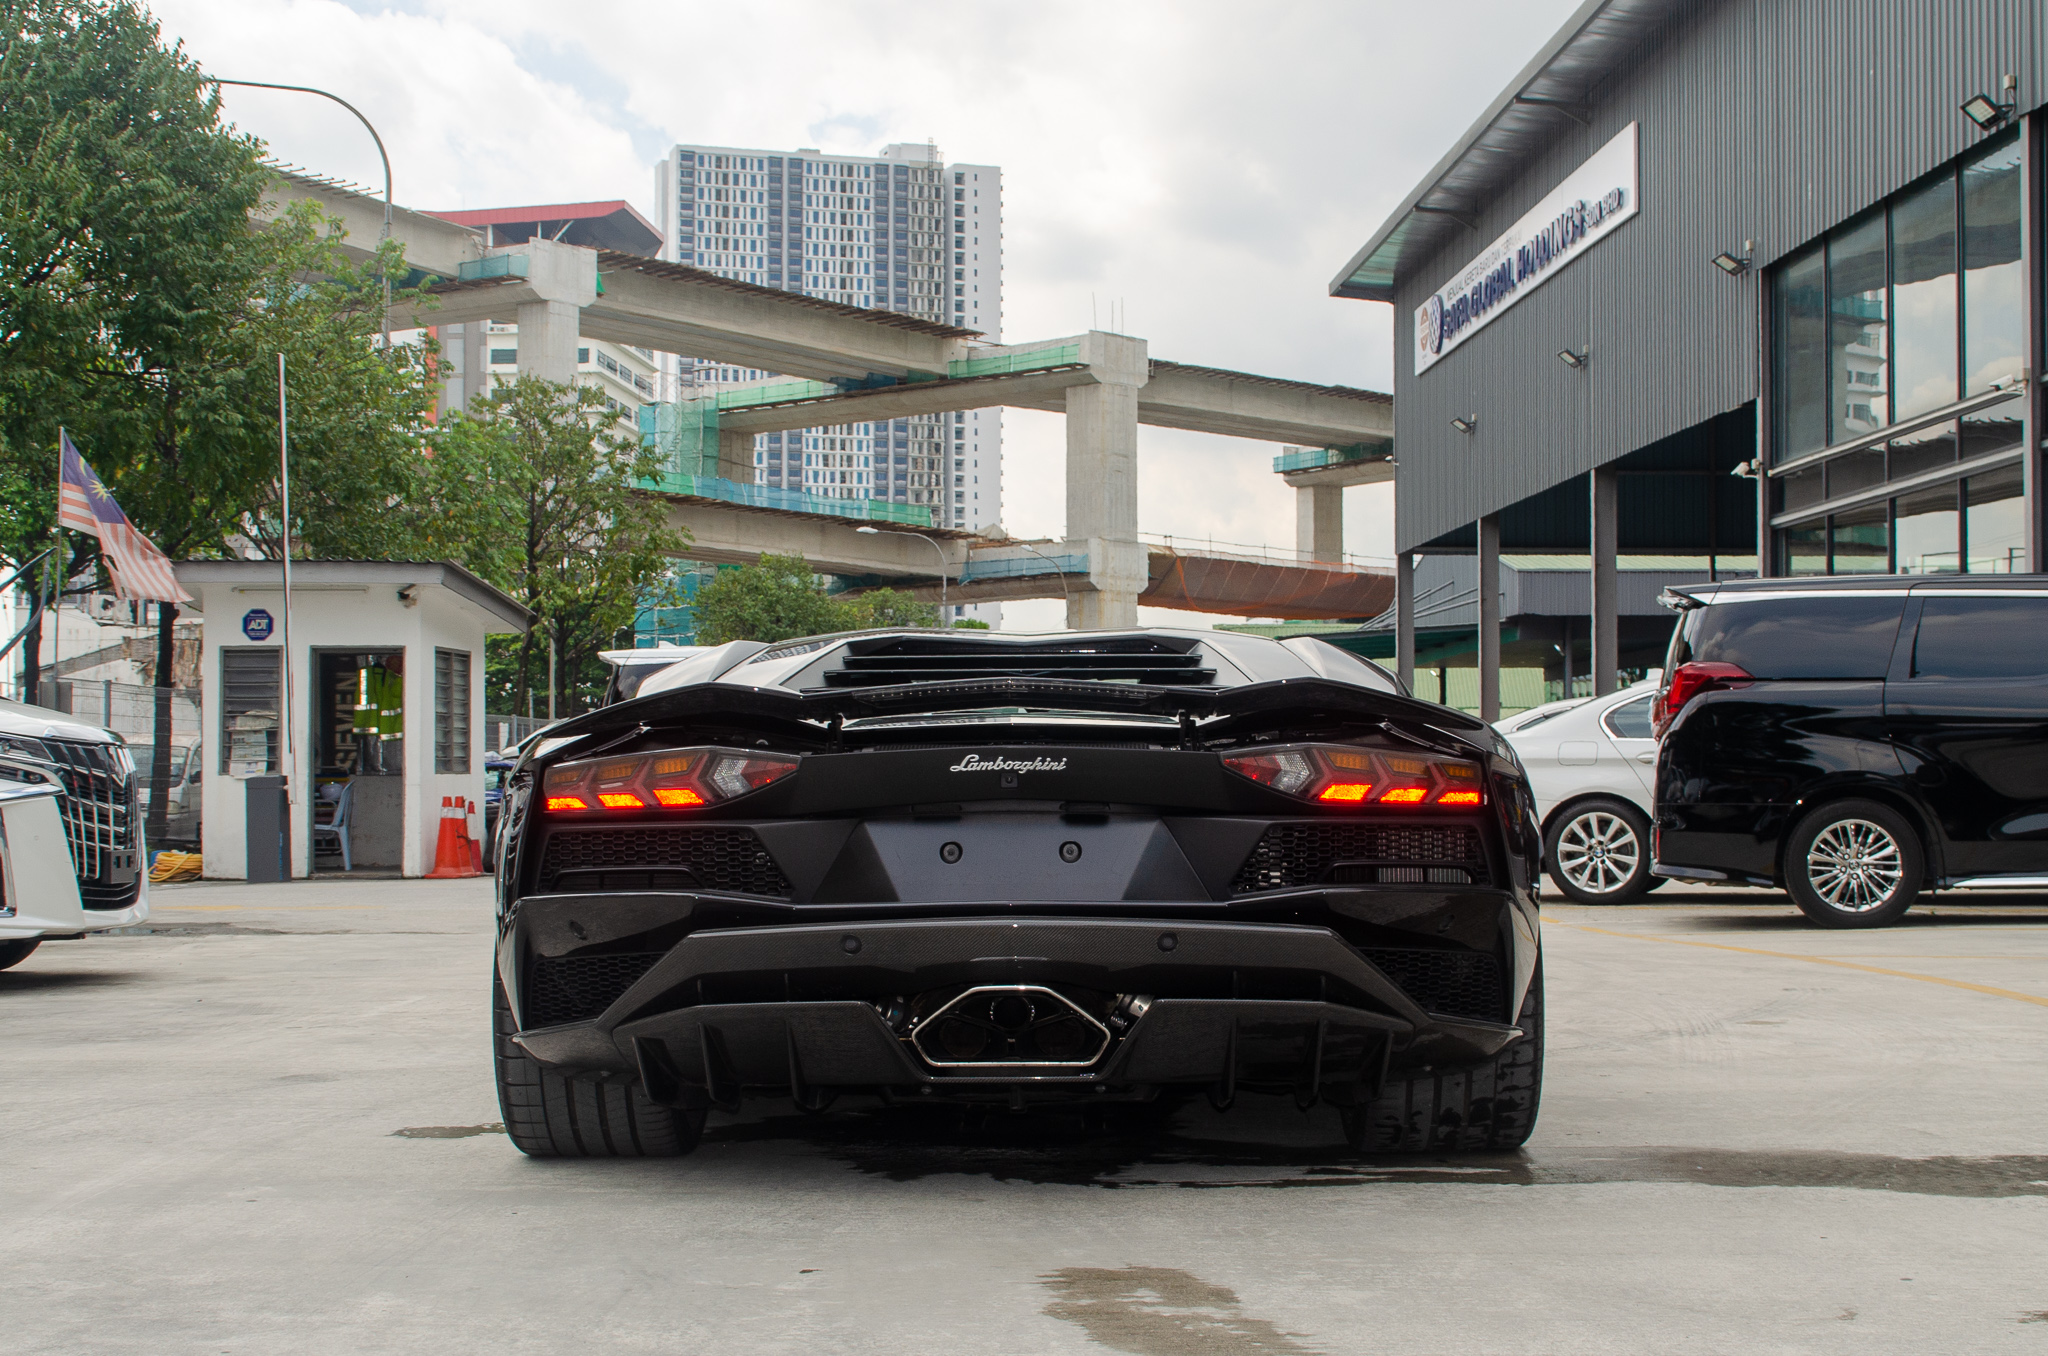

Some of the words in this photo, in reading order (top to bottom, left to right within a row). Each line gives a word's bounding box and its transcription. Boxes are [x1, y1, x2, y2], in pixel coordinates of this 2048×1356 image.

[1470, 258, 1515, 317] GLOBAL
[1516, 200, 1585, 282] HOLDINGS
[1584, 201, 1602, 228] SDN
[248, 619, 269, 630] ADT
[950, 754, 1067, 774] Lamborghini
